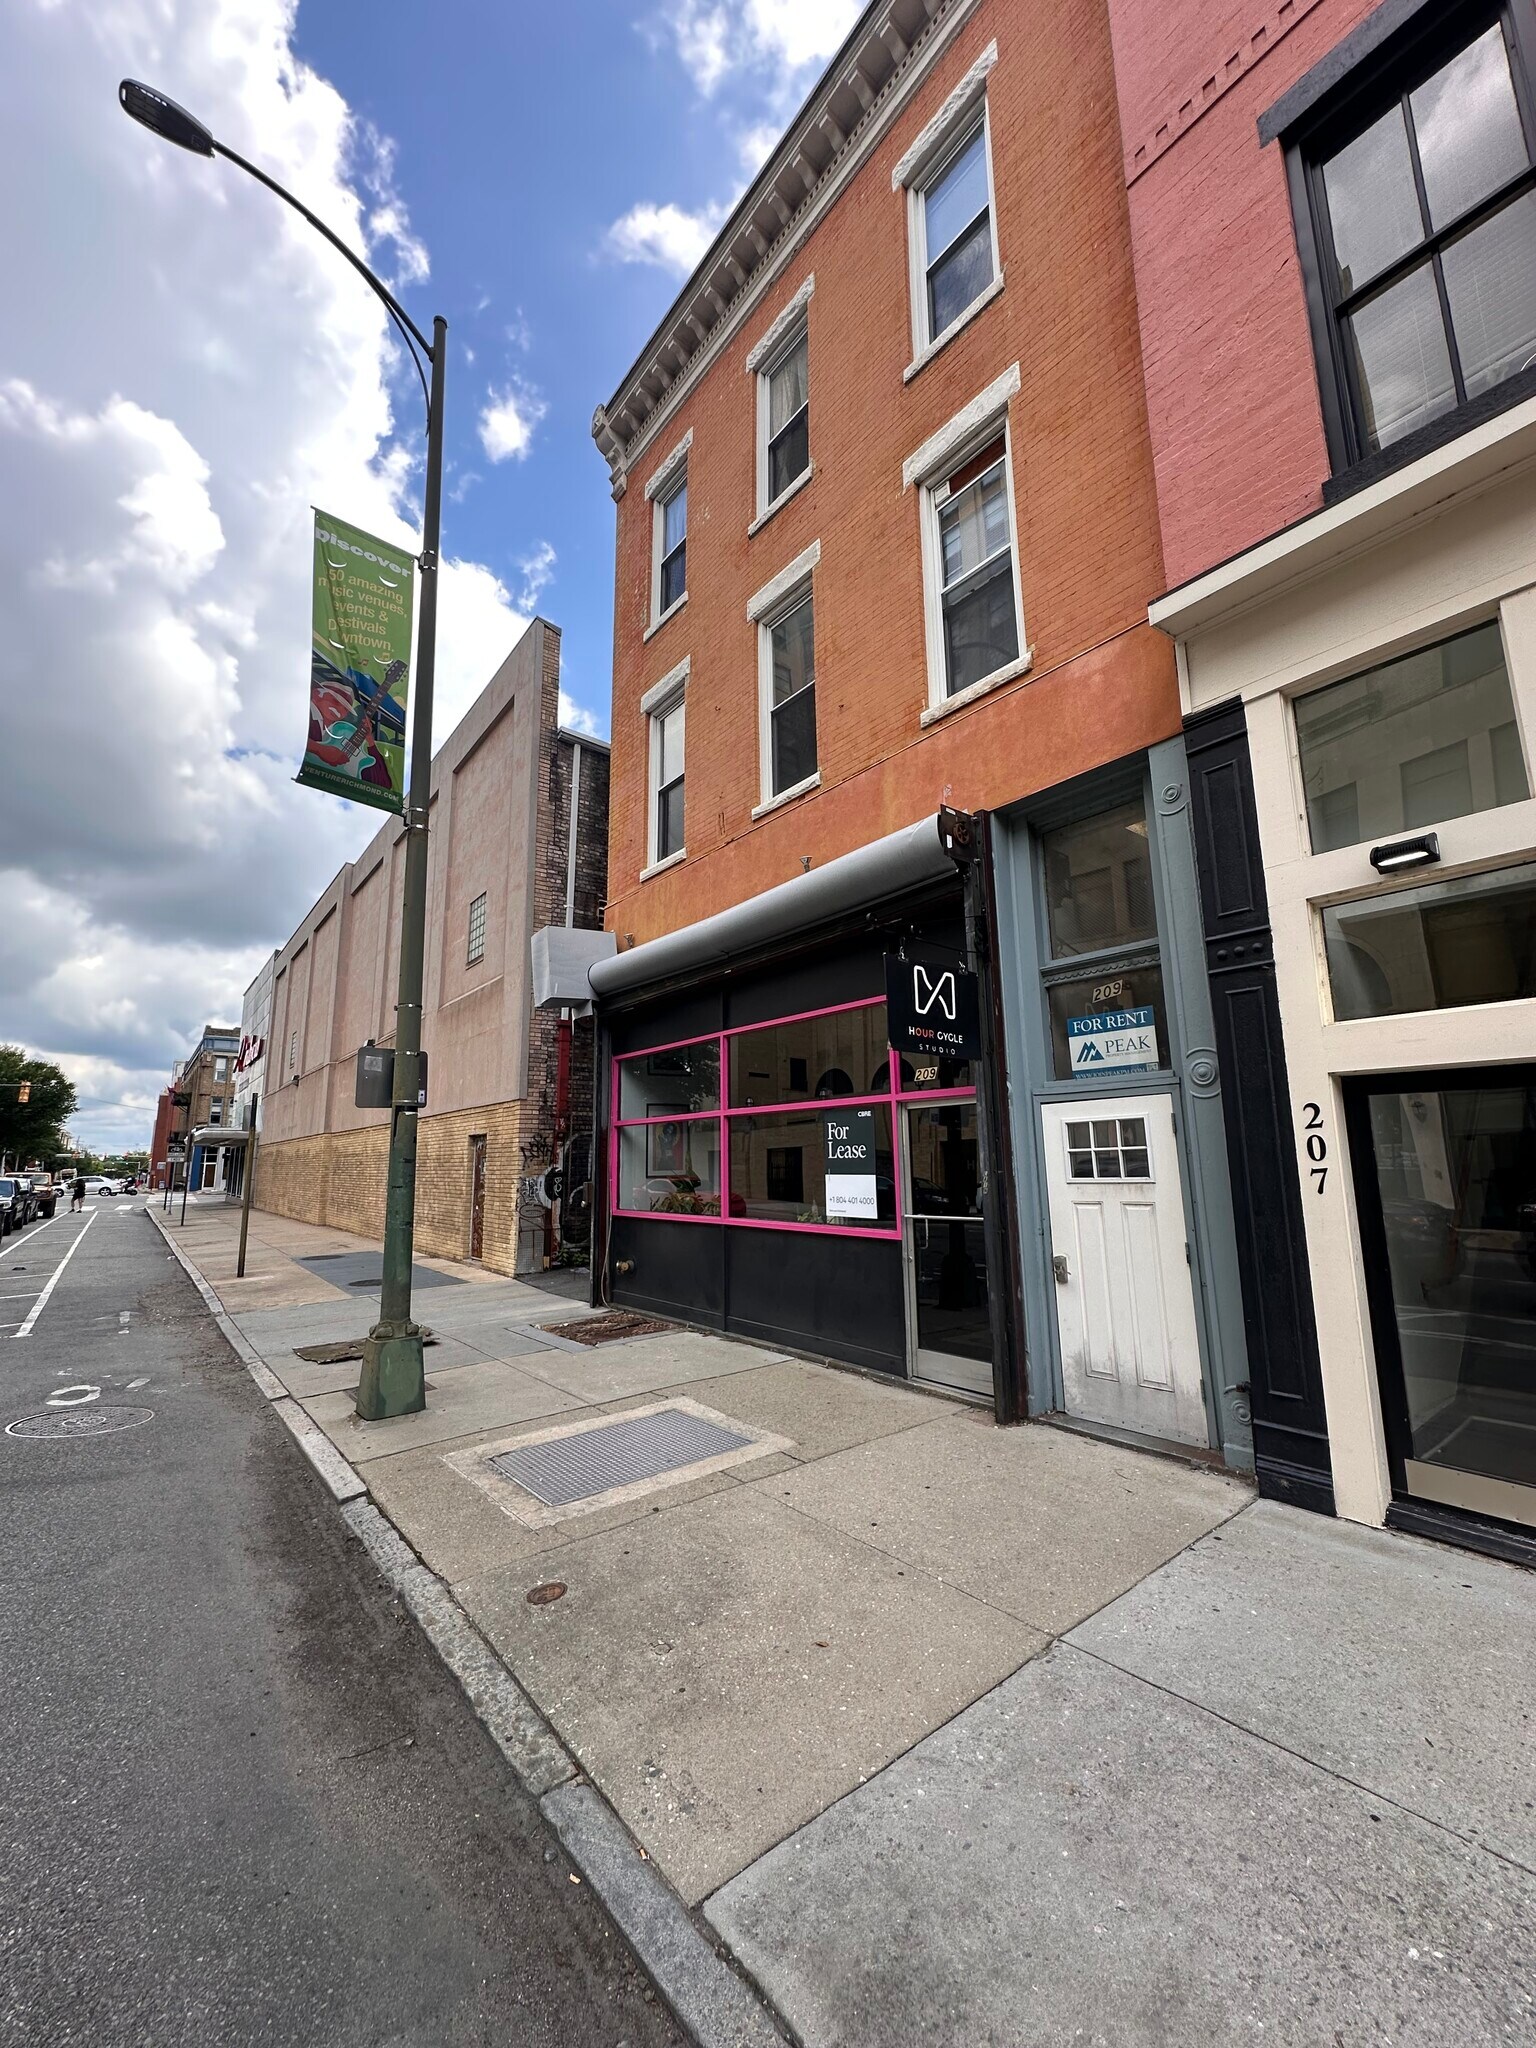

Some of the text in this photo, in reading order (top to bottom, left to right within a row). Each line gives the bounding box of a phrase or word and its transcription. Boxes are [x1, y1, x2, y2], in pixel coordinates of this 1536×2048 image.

[316, 527, 411, 577] Discover
[328, 569, 404, 605] 50 amazing
[358, 592, 408, 619] venues,
[379, 610, 389, 622] &
[337, 616, 387, 635] estivals
[304, 766, 400, 801] VENTURERICHMOND.COM
[1093, 982, 1122, 1001] 209
[1073, 1010, 1148, 1033] FOR RENT
[908, 1026, 964, 1044] HOUR CYCLE
[1104, 1035, 1151, 1053] PEAK
[919, 1043, 956, 1055] STUDIO
[915, 1068, 937, 1081] 209
[827, 1122, 850, 1140] For
[827, 1141, 867, 1159] Lease
[1302, 1102, 1328, 1195] 207
[836, 1196, 847, 1204] 804
[847, 1196, 858, 1204] 401
[858, 1197, 875, 1205] 4000
